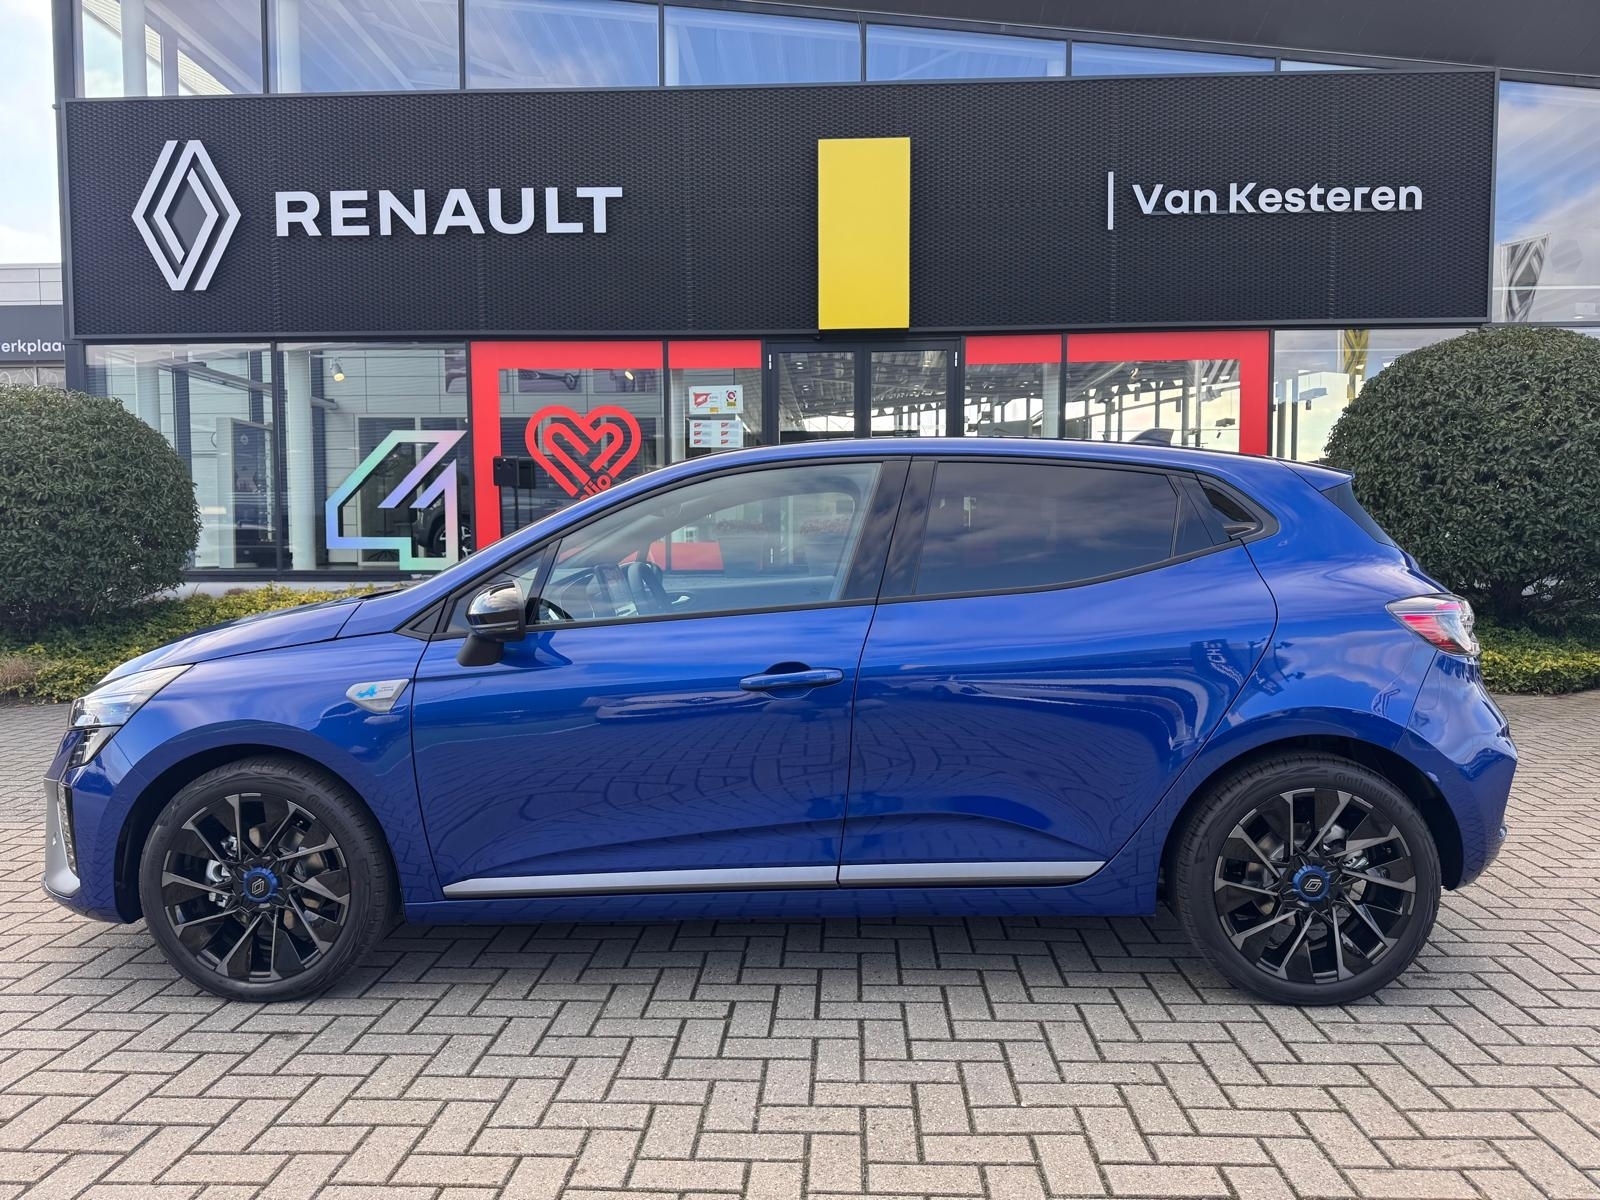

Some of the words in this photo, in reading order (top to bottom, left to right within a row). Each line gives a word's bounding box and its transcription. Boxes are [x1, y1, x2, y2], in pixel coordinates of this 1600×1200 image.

[275, 186, 623, 237] RENAULT
[1132, 183, 1218, 215] Van
[1229, 182, 1423, 214] Kesteren
[1, 339, 65, 355] erkplaa
[580, 475, 611, 501] lio
